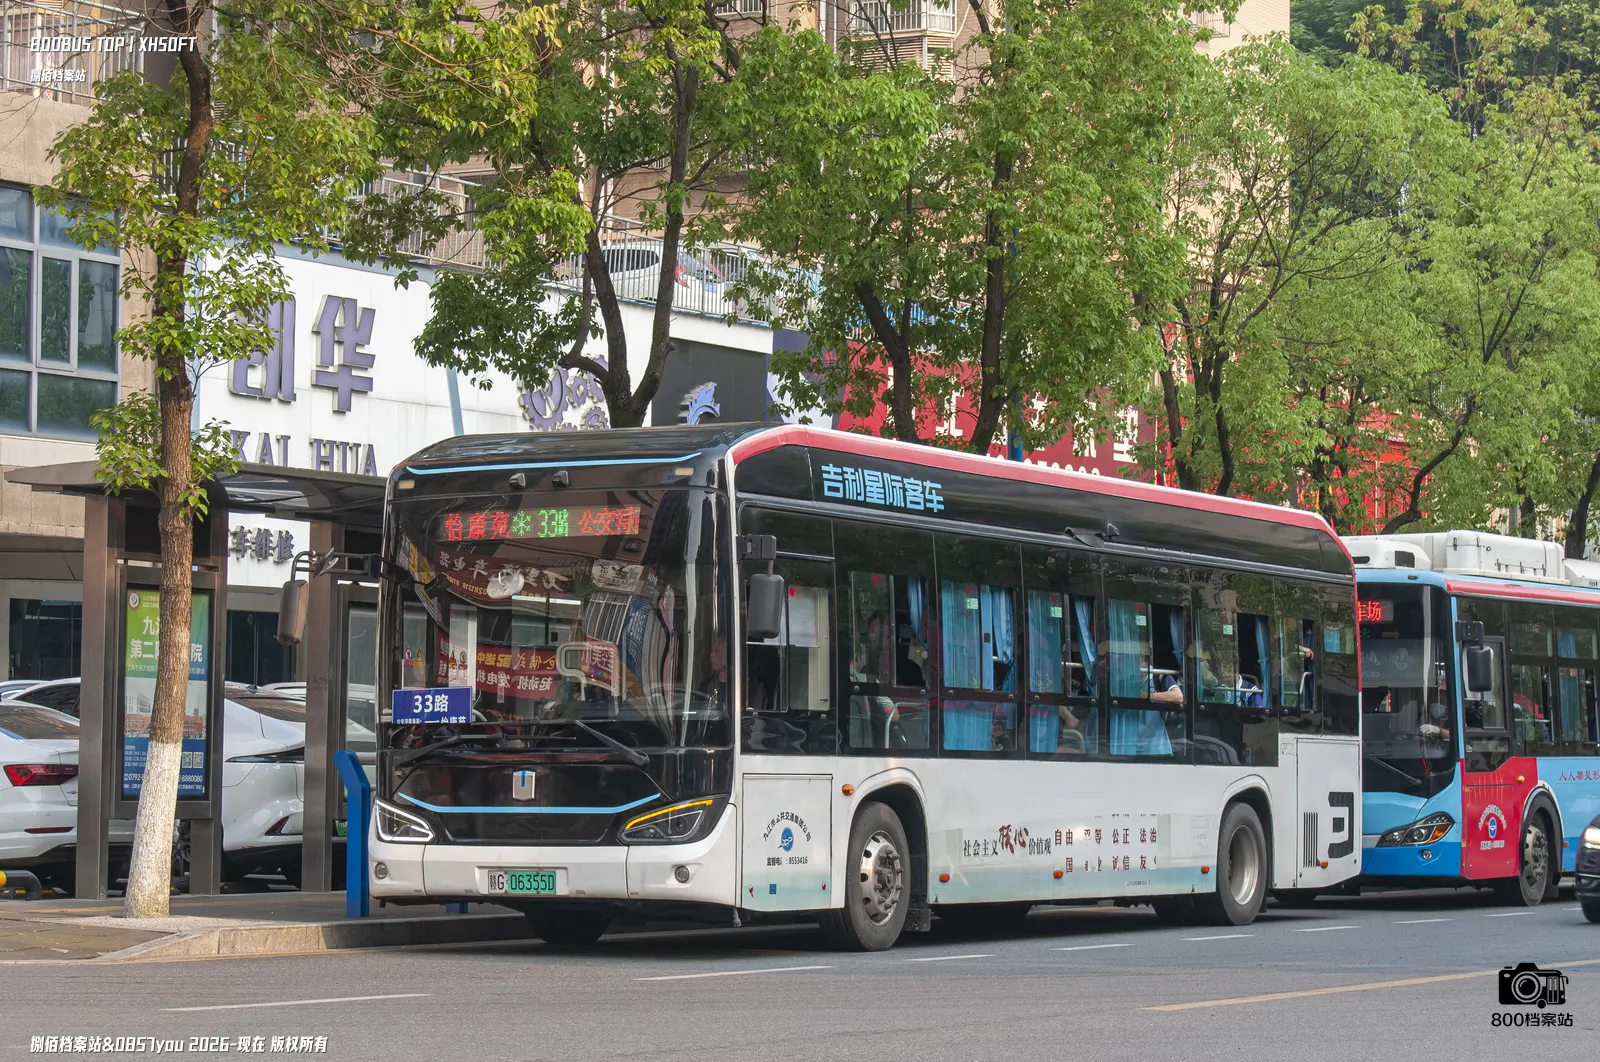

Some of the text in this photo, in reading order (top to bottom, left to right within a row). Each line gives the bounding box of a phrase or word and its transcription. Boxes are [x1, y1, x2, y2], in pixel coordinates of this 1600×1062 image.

[228, 430, 378, 477] KAI HUA
[821, 463, 945, 513] 吉利星际客车
[228, 525, 295, 564] 车维修
[413, 694, 449, 714] 33路
[1054, 829, 1073, 846] 自由
[1112, 828, 1130, 844] 公正
[1139, 827, 1157, 843] 法治
